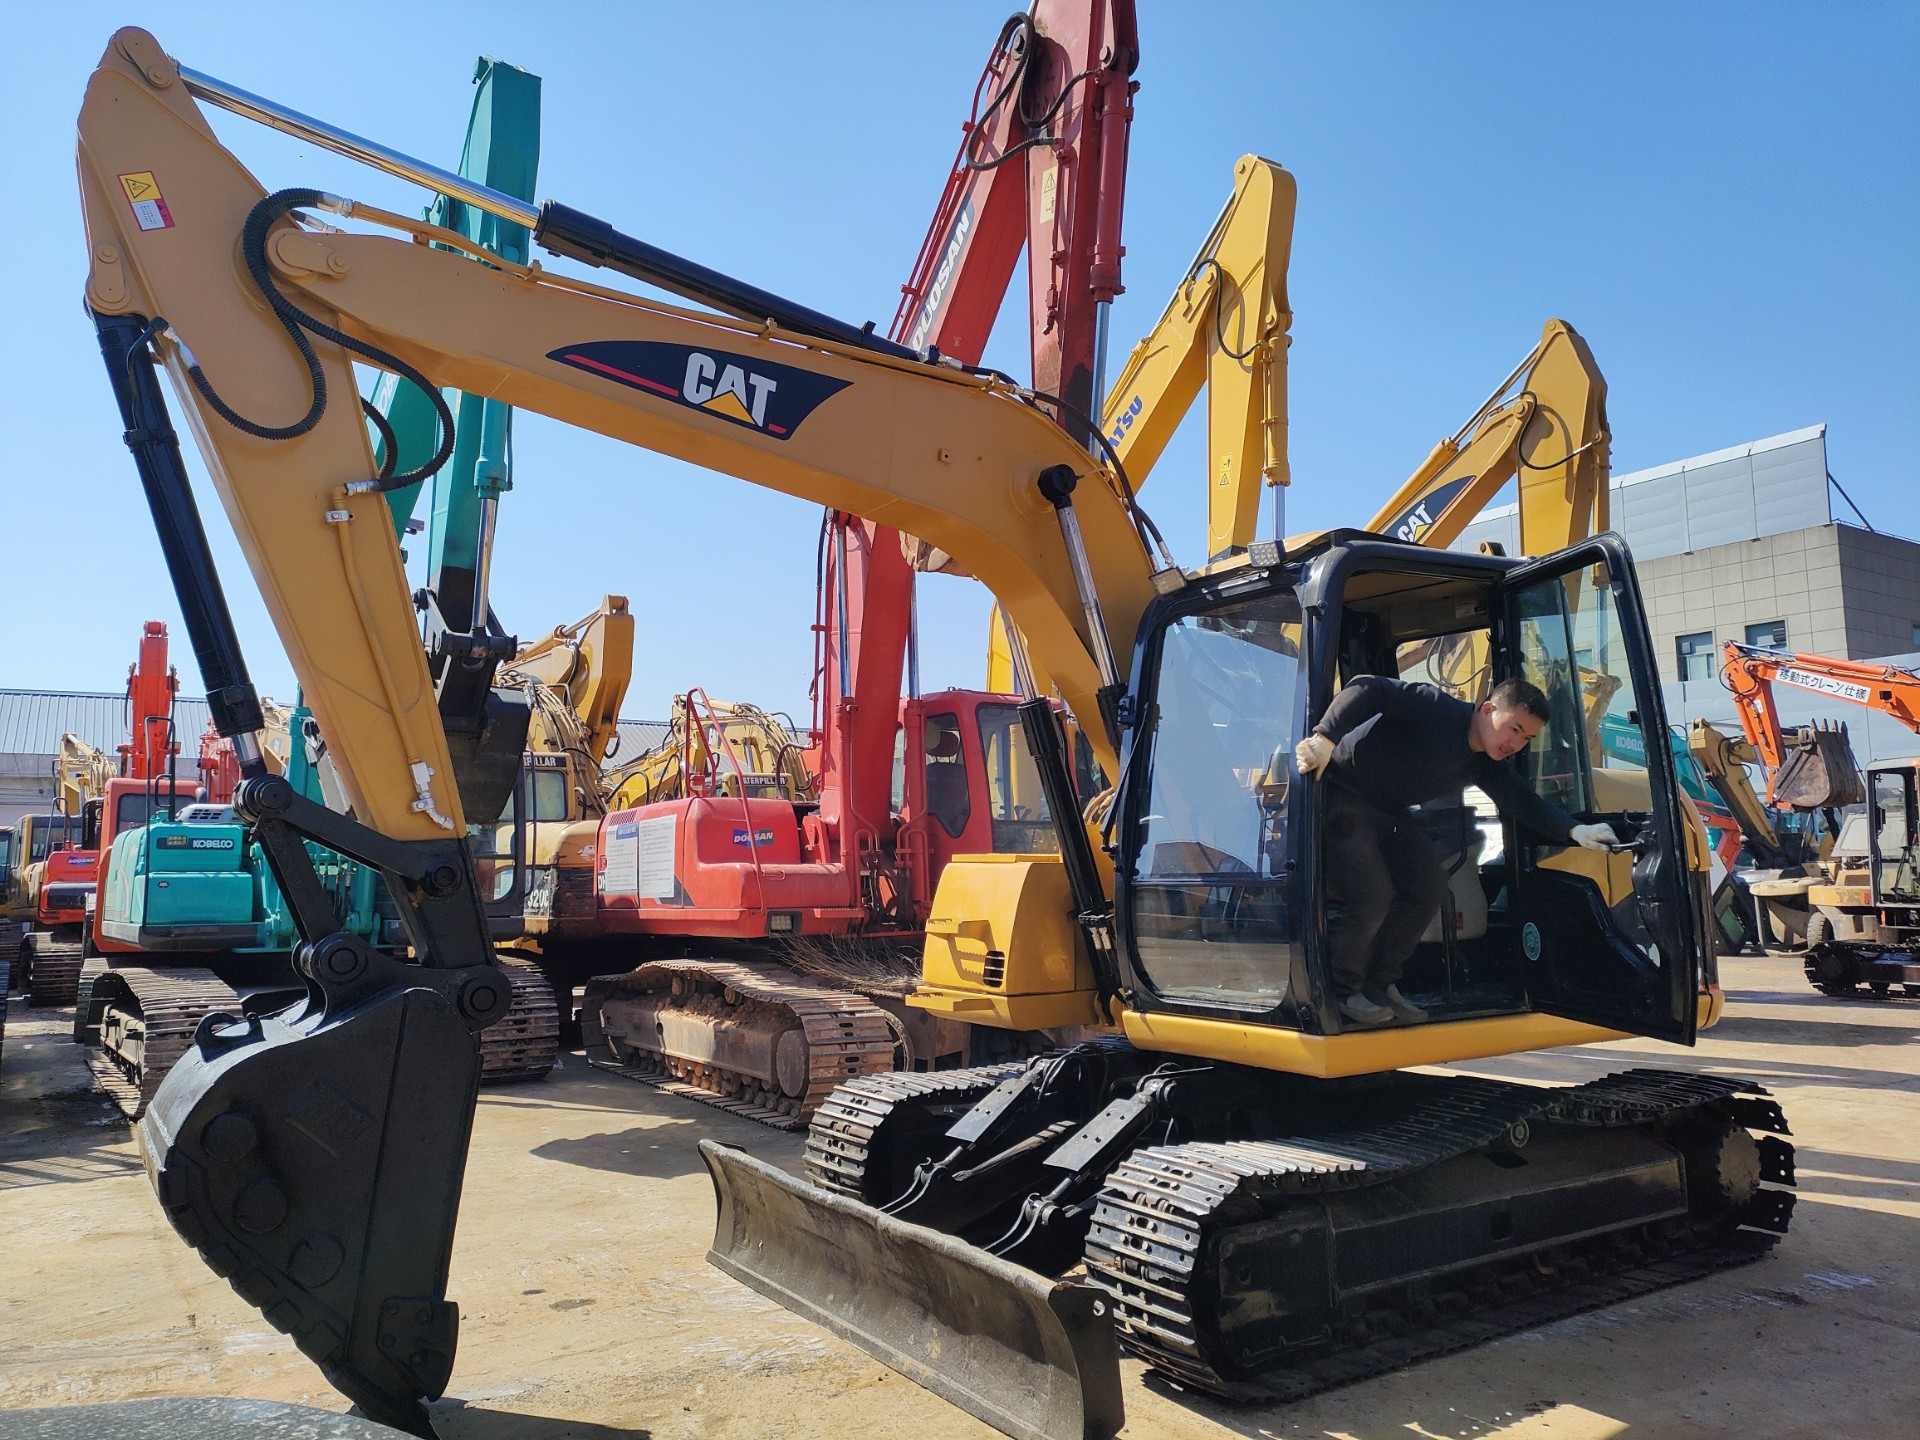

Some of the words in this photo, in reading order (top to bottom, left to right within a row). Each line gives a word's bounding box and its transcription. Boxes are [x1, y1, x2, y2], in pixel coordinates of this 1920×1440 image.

[683, 352, 777, 427] CAT
[1397, 503, 1433, 542] CAT
[1779, 668, 1867, 700] 移動式クレーン仕様
[192, 839, 234, 849] KOBELCO
